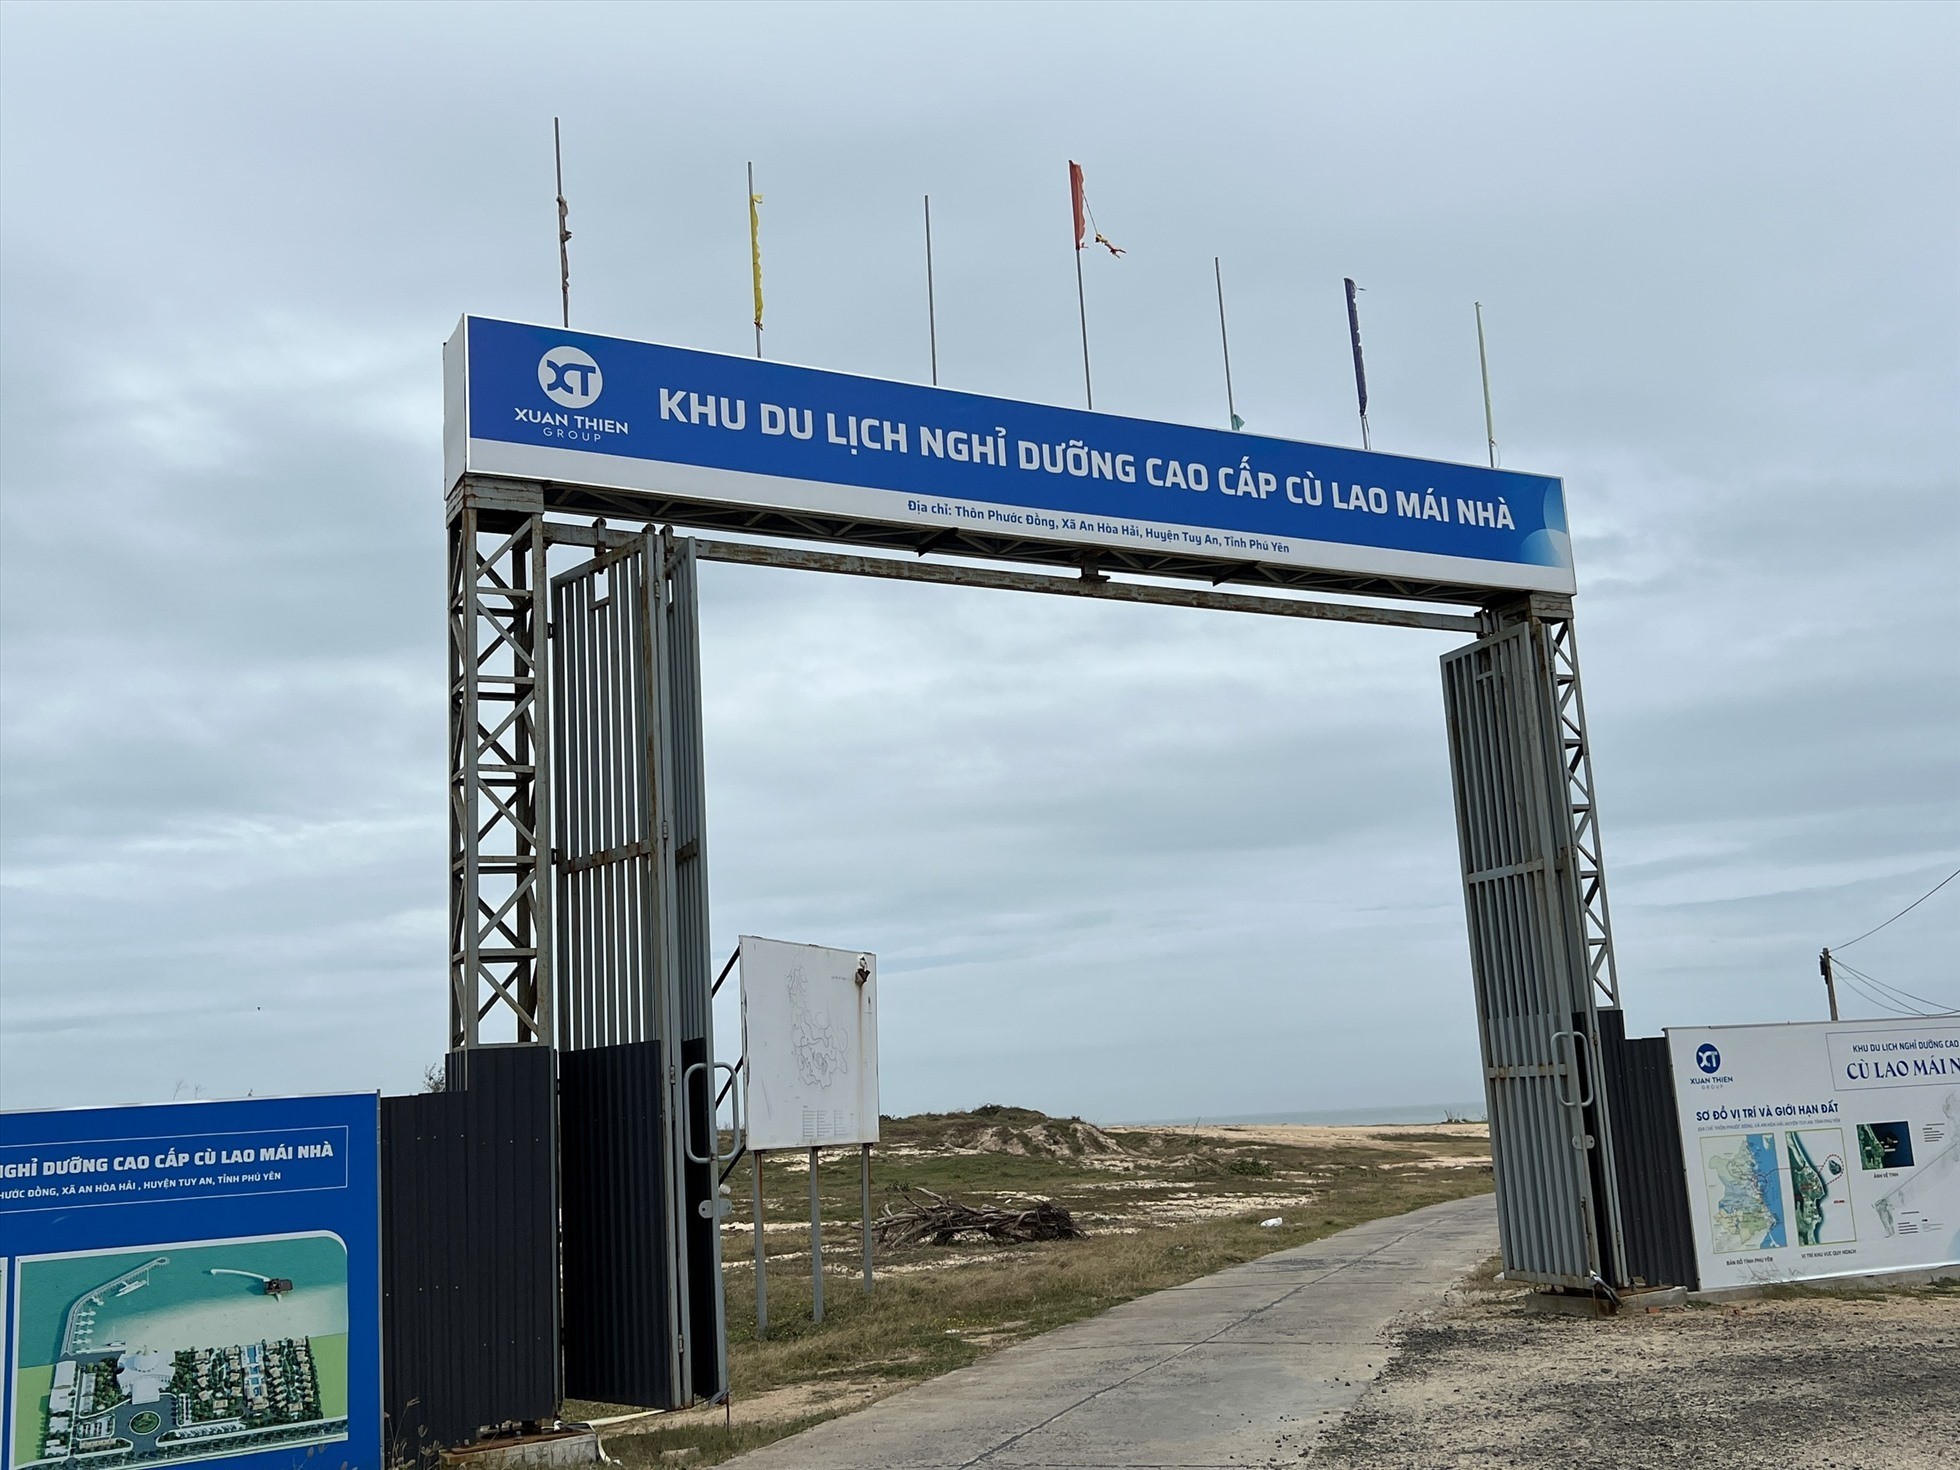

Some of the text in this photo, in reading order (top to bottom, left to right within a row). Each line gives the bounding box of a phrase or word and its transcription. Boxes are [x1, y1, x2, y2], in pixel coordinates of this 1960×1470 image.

[547, 359, 596, 397] XT
[514, 408, 629, 434] XUAN THIEN
[543, 427, 602, 442] GROUP
[659, 387, 1516, 531] KHU DU LỊCH NGHỈ DƯỠNG CAO CẤP CÙ LAO MÁI NHÀ
[908, 499, 1291, 554] Địa chỉ: Thôn Phước Đồng, Xã An Hòa Hải, Huyện Tuy An, Tỉnh Phú Yên
[1852, 1045, 1869, 1053] KHU
[1870, 1044, 1881, 1052] DU
[1945, 1039, 1960, 1048] CAO
[1846, 1058, 1870, 1080] CÙ
[1873, 1060, 1909, 1079] LAO
[1913, 1055, 1947, 1076] MÁI
[1689, 1077, 1711, 1085] XUAN
[1696, 1109, 1710, 1121] SƠ
[1730, 1109, 1741, 1122] VỊ
[1742, 1105, 1757, 1118] TRÍ
[1758, 1104, 1773, 1117] VÀ
[1774, 1103, 1796, 1116] GIỚI
[1798, 1104, 1819, 1117] HẠN
[1820, 1099, 1839, 1113] ĐẤT
[0, 1141, 334, 1179] GHỈ DƯỠNG CAO CẤP CÙ LAO MÁI NHÀ
[0, 1188, 25, 1200] HƯỚC
[62, 1184, 76, 1195] XÃ
[79, 1184, 94, 1193] AN
[95, 1181, 117, 1192] HÒA
[118, 1180, 136, 1191] HẢI
[143, 1177, 176, 1190] HUYỆN
[178, 1178, 197, 1187] TUY
[199, 1177, 216, 1186] AN,
[218, 1173, 240, 1184] TỈNH
[242, 1172, 261, 1182] PHÚ
[263, 1170, 282, 1181] YÊN
